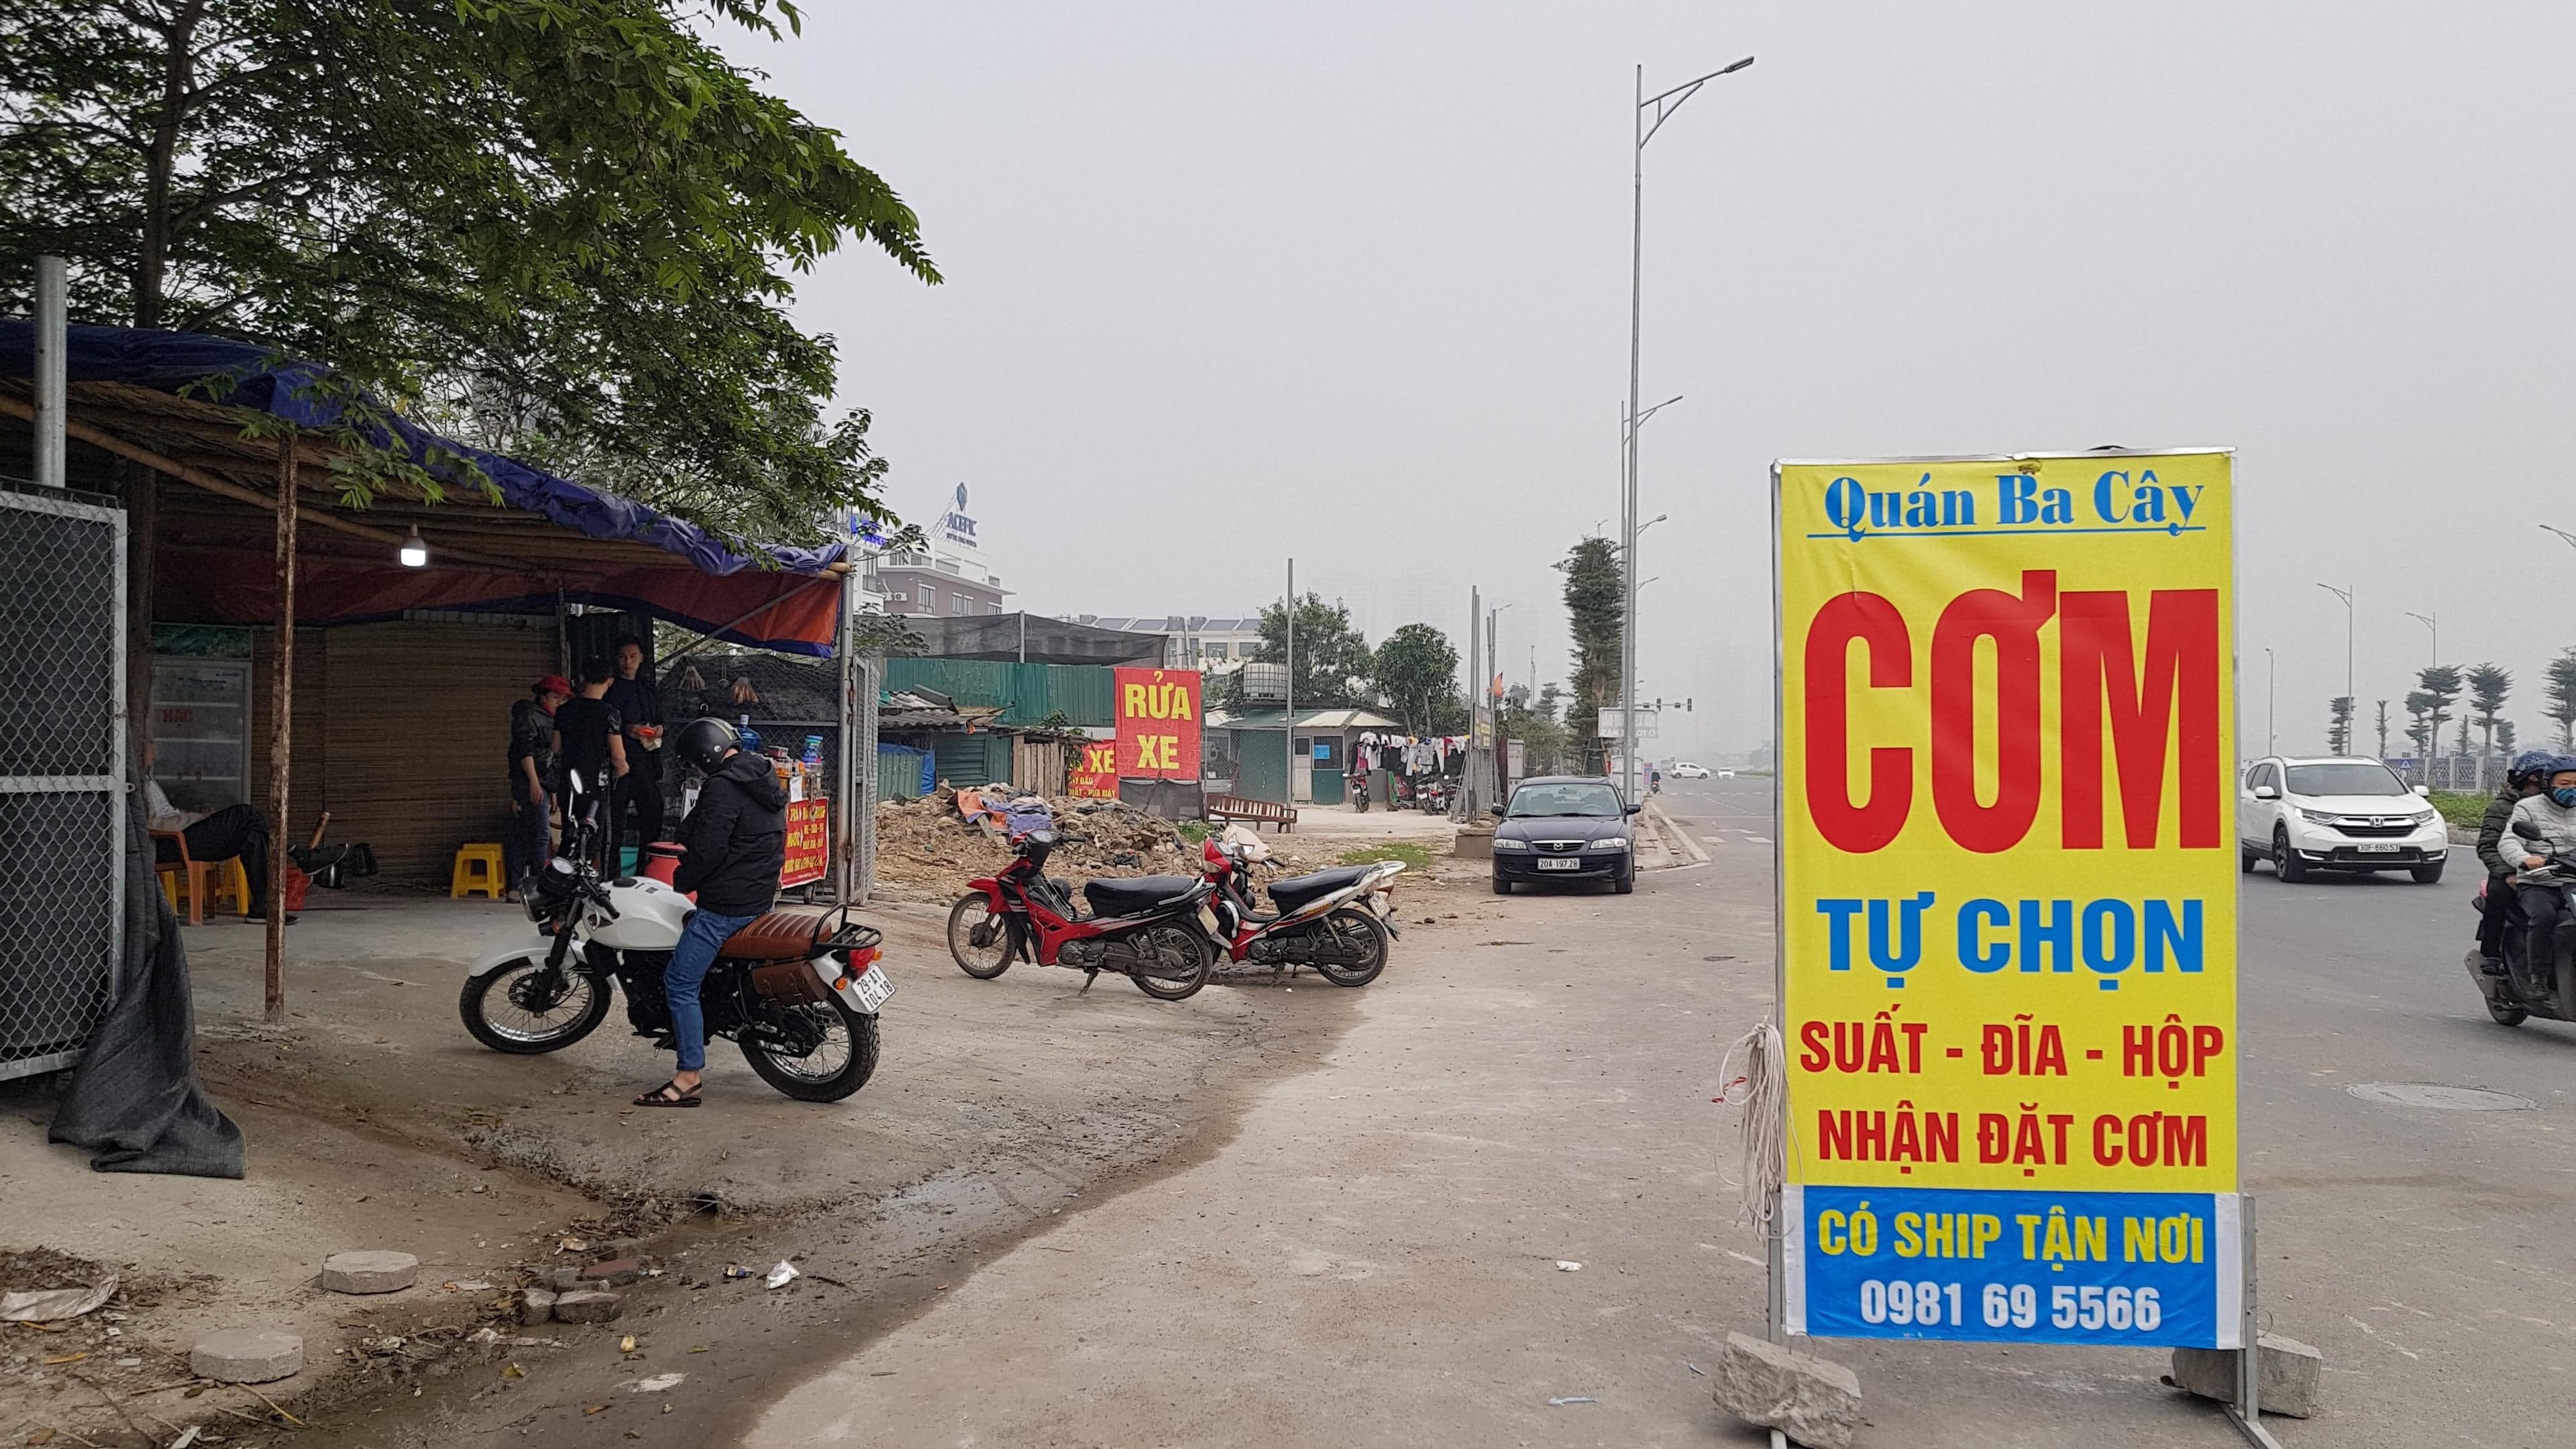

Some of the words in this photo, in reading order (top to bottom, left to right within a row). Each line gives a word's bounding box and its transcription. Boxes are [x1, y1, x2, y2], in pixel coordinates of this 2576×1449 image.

[1824, 472, 1977, 542] Quán
[1994, 474, 2074, 525] Ba
[2093, 470, 2204, 535] Cây
[1124, 671, 1192, 720] RỬA
[1805, 570, 2220, 853] CƠM
[1088, 749, 1116, 773] XE
[1136, 735, 1179, 769] XE
[1816, 891, 1935, 988] TỰ
[1957, 898, 2204, 990] CHỌN
[1800, 1004, 1927, 1073] SUẤT
[1981, 1014, 2068, 1077] ĐĨA
[2123, 1014, 2224, 1089] HỘP
[1818, 1100, 1959, 1175] NHẬN
[1976, 1102, 2074, 1177] ĐẶT
[2093, 1110, 2208, 1168] CƠM
[1817, 1201, 1878, 1257] CÓ
[1893, 1210, 2002, 1259] SHIP
[2016, 1205, 2108, 1271] TẬN
[2123, 1212, 2204, 1264] NƠI
[1860, 1279, 1963, 1326] 0981
[1982, 1283, 2037, 1330] 69
[2051, 1285, 2161, 1332] 5566
